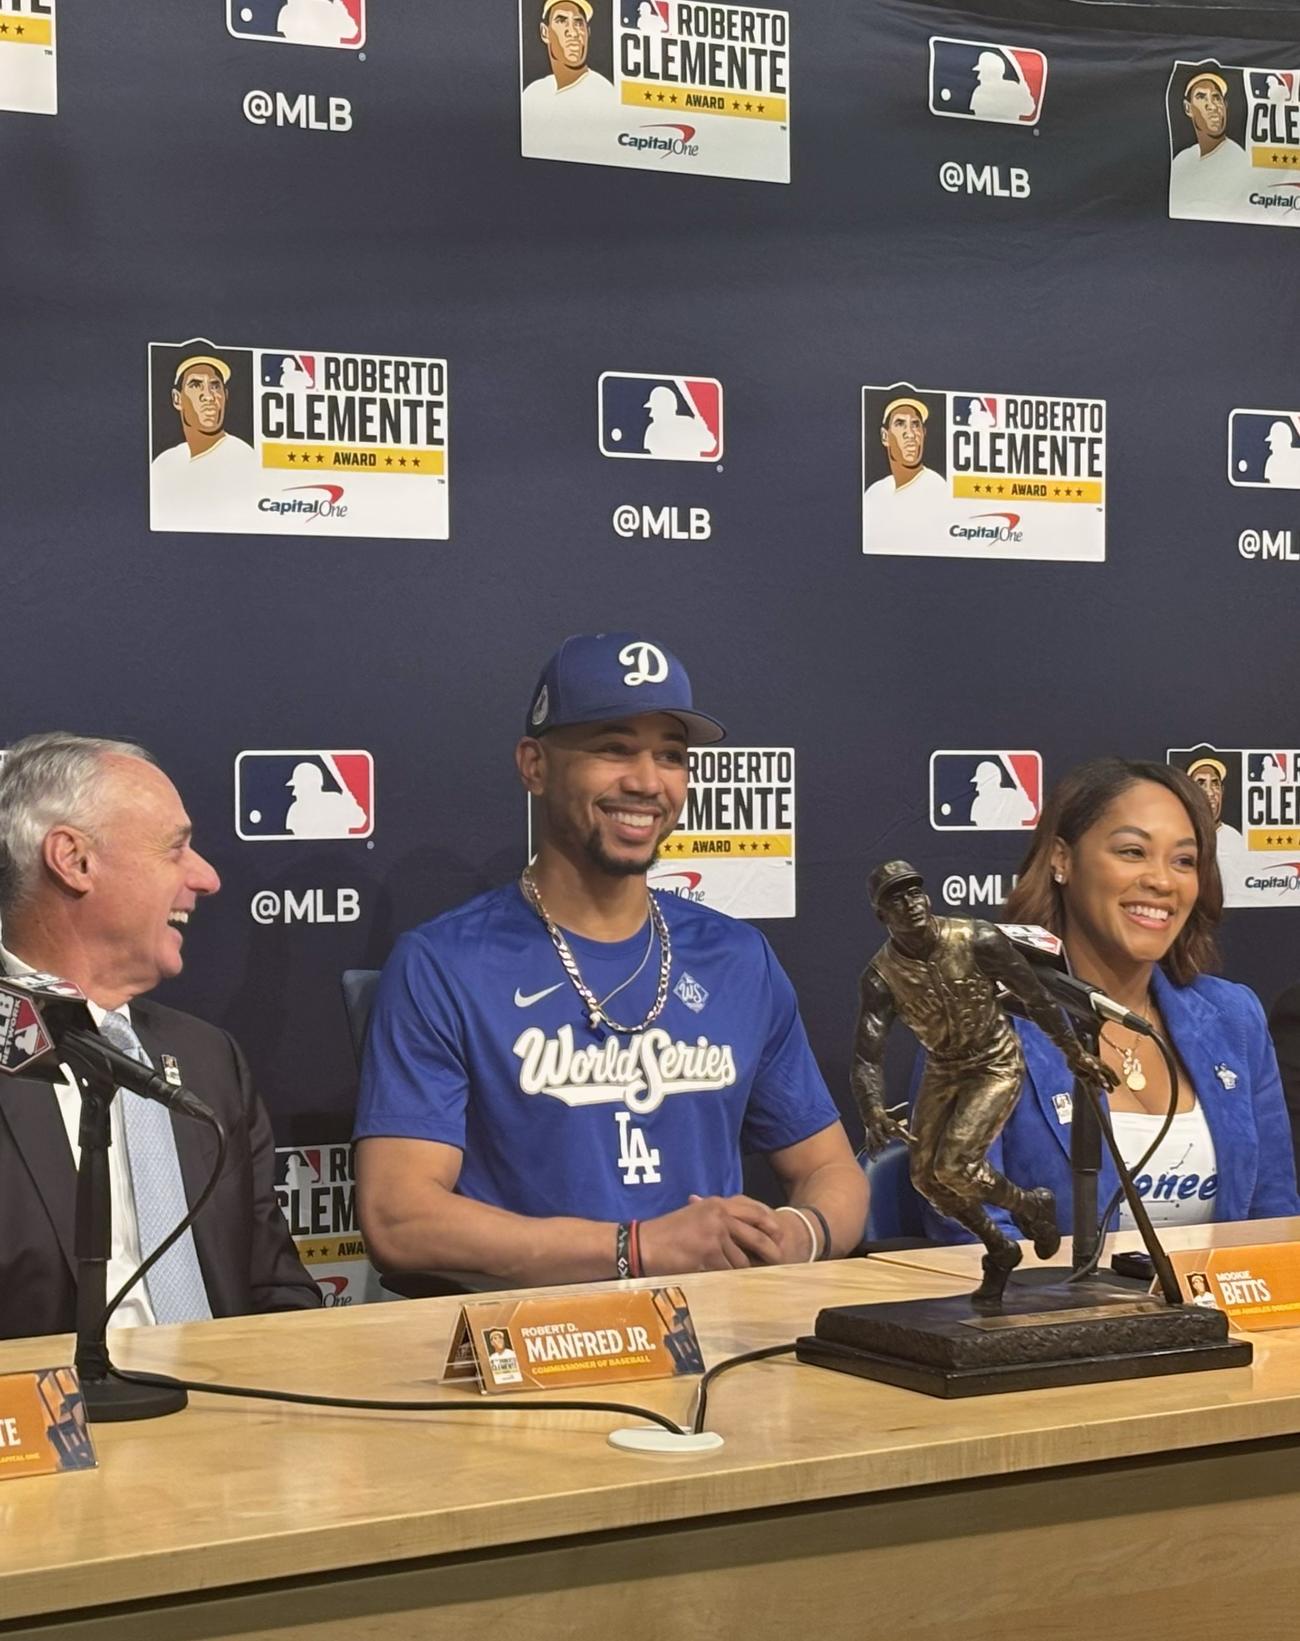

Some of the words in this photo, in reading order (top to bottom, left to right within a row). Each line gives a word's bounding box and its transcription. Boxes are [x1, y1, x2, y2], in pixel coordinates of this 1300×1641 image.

[677, 3, 787, 48] ROBERTO
[620, 33, 787, 94] CLEMENTE
[243, 90, 353, 132] @MLB
[685, 94, 726, 110] AWARD
[939, 161, 1032, 199] @MLB
[324, 355, 445, 397] ROBERTO
[260, 391, 445, 446] CLEMENTE
[1005, 398, 1103, 432] ROBERTO
[333, 451, 377, 468] AWARD
[952, 430, 1103, 477] CLEMENTE
[1011, 483, 1048, 498] AWARD
[612, 504, 712, 541] @MLB
[618, 641, 669, 687] D
[677, 787, 791, 830] MENTE
[692, 840, 731, 853] AWARD
[251, 887, 361, 925] @MLB
[942, 875, 1019, 906] @ML
[614, 1112, 661, 1185] LA
[338, 1241, 367, 1256] AWA
[1219, 1278, 1272, 1305] BETTS
[521, 1323, 566, 1338] ROBERT
[566, 1322, 579, 1333] D.
[524, 1329, 624, 1363] MANFRED
[625, 1326, 657, 1352] JR.
[532, 1360, 597, 1375] COMMISSIONER
[609, 1355, 651, 1367] BASEBALL
